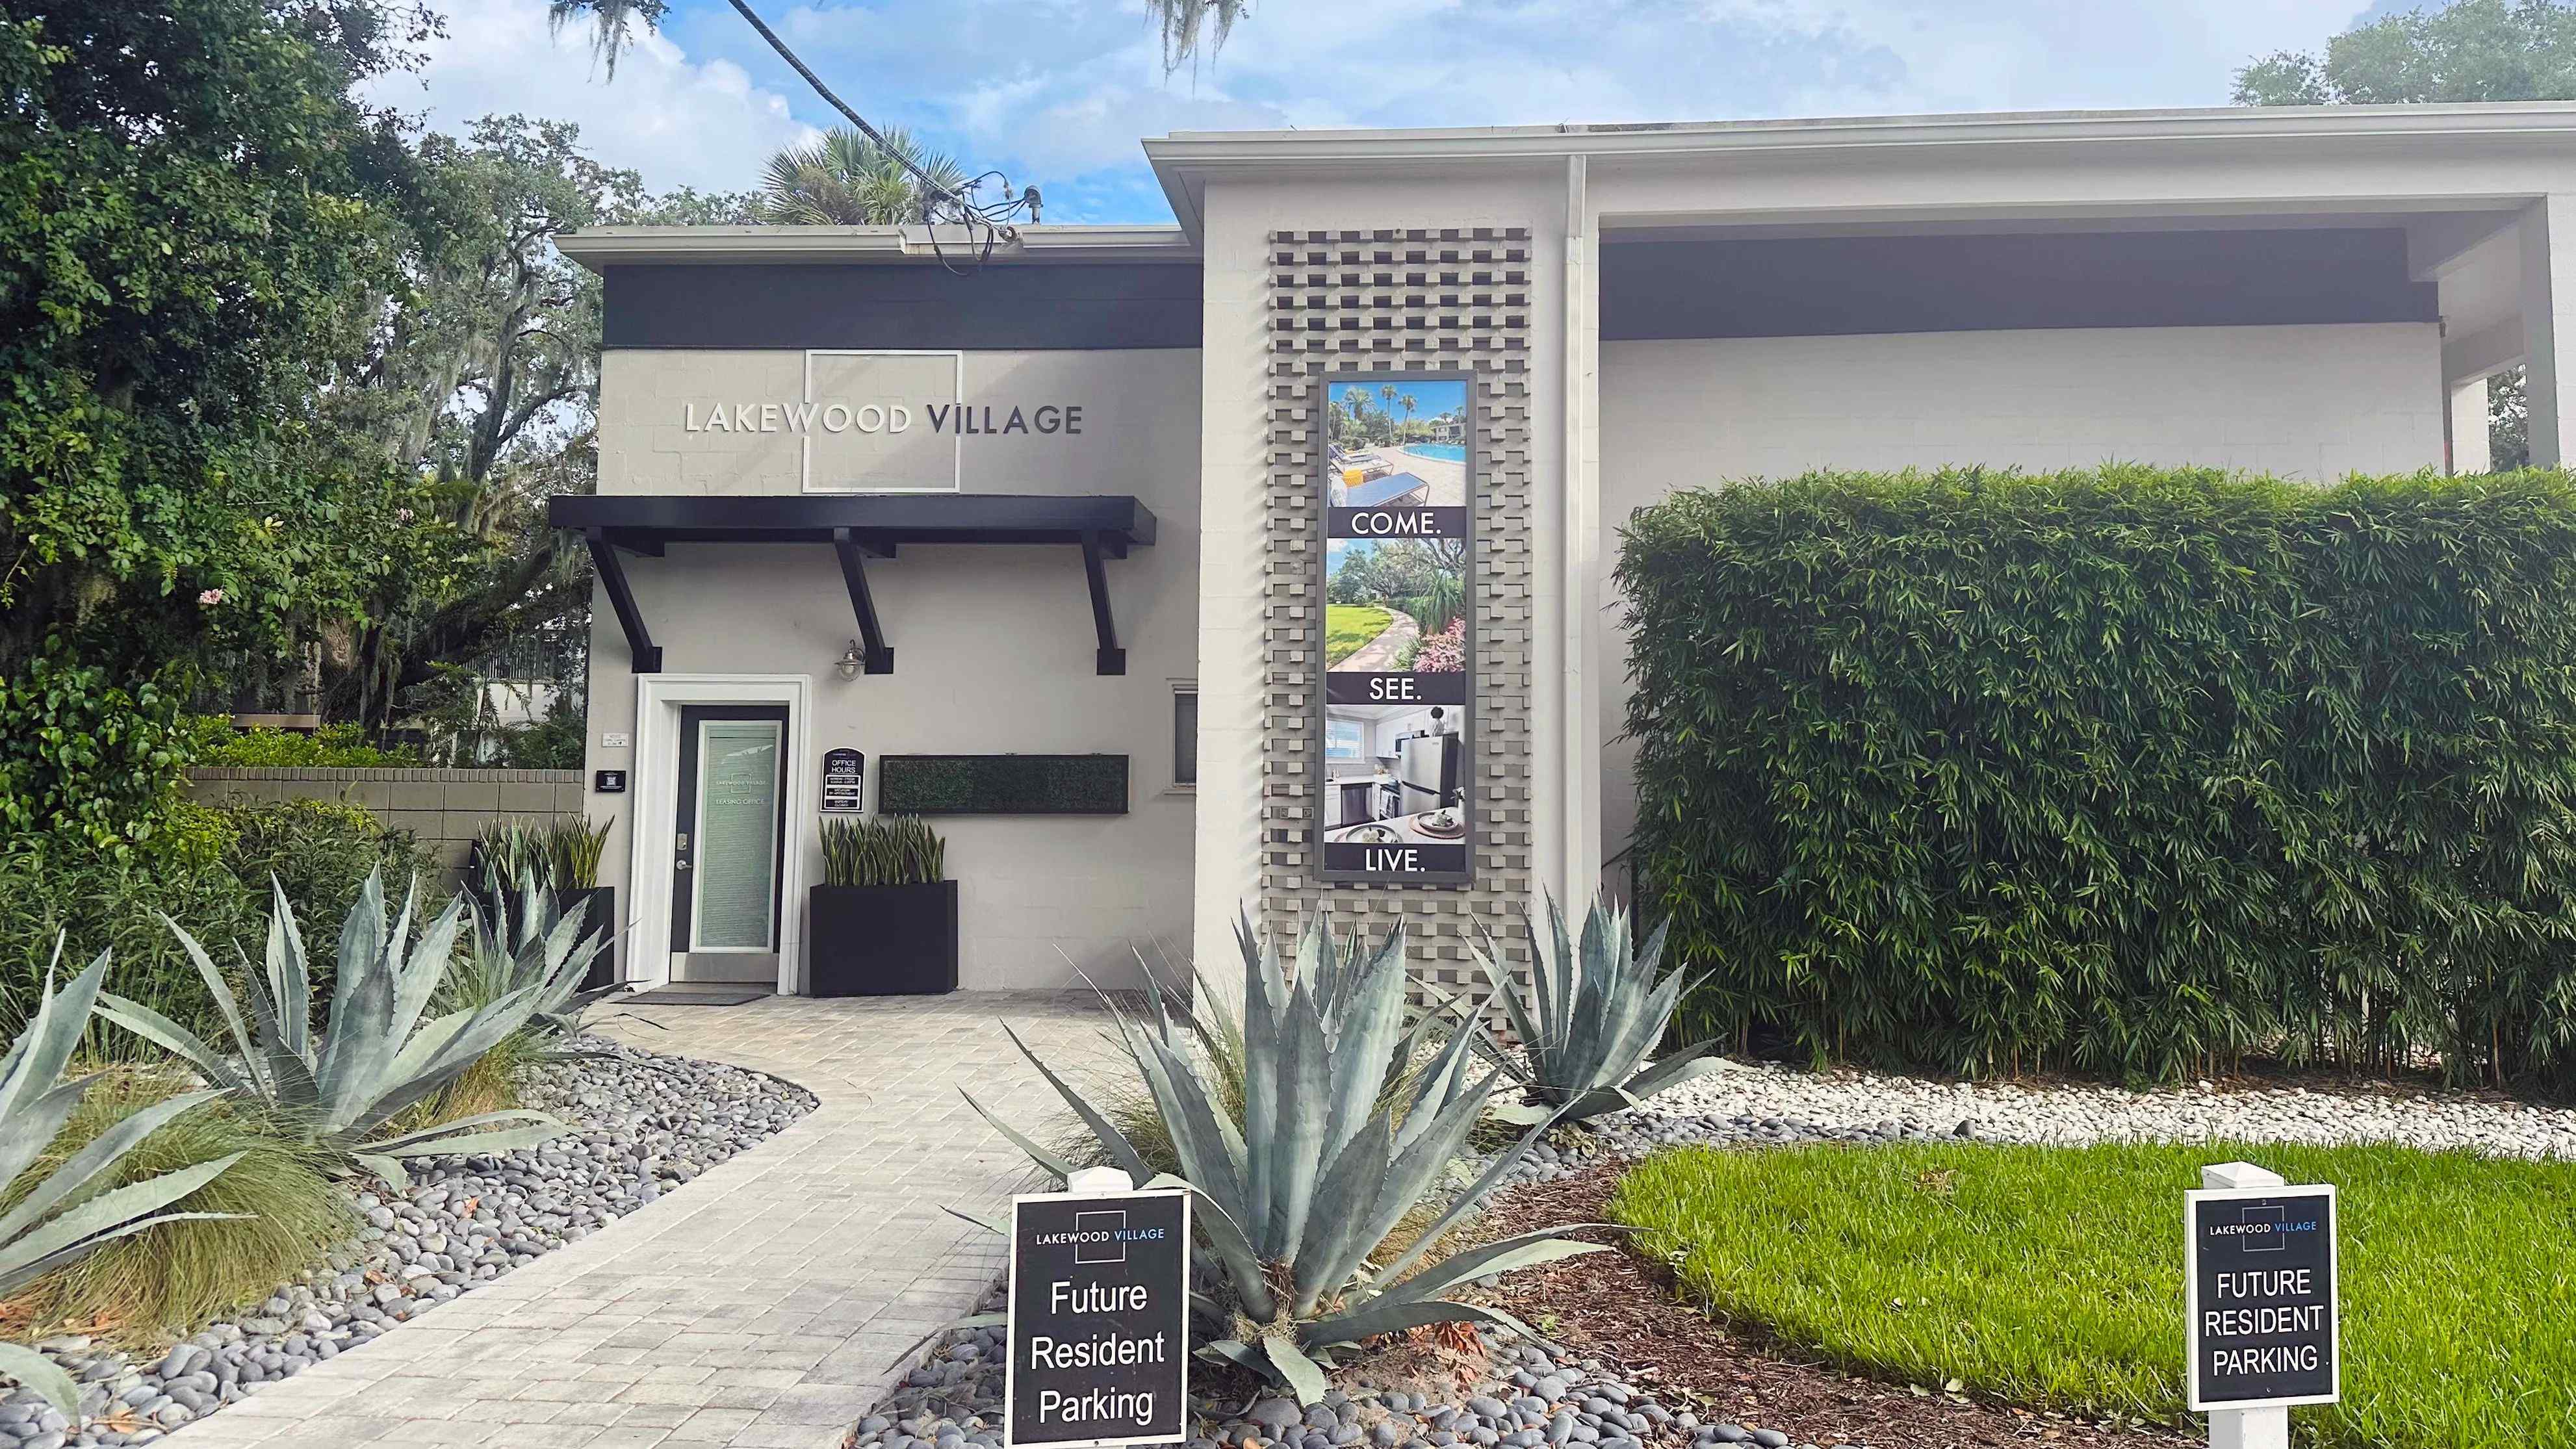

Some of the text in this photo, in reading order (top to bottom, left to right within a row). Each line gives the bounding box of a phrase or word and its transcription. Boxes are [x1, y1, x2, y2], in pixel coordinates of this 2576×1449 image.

[686, 402, 1083, 435] LAKEWOOD VILLAGE
[1351, 511, 1441, 535] COME.
[1369, 677, 1422, 700] SEE.
[1366, 849, 1425, 872] LIVE.
[1036, 1228, 1165, 1245] LAKEWOOD VILLAGE
[2209, 1221, 2317, 1236] LAKEWOOD VILLAGE
[1050, 1280, 1148, 1314] Future
[2217, 1268, 2312, 1299] FUTURE
[2205, 1305, 2325, 1337] RESIDENT
[1031, 1330, 1165, 1370] Resident
[2213, 1344, 2318, 1377] PARKING
[1039, 1386, 1154, 1426] Parking
